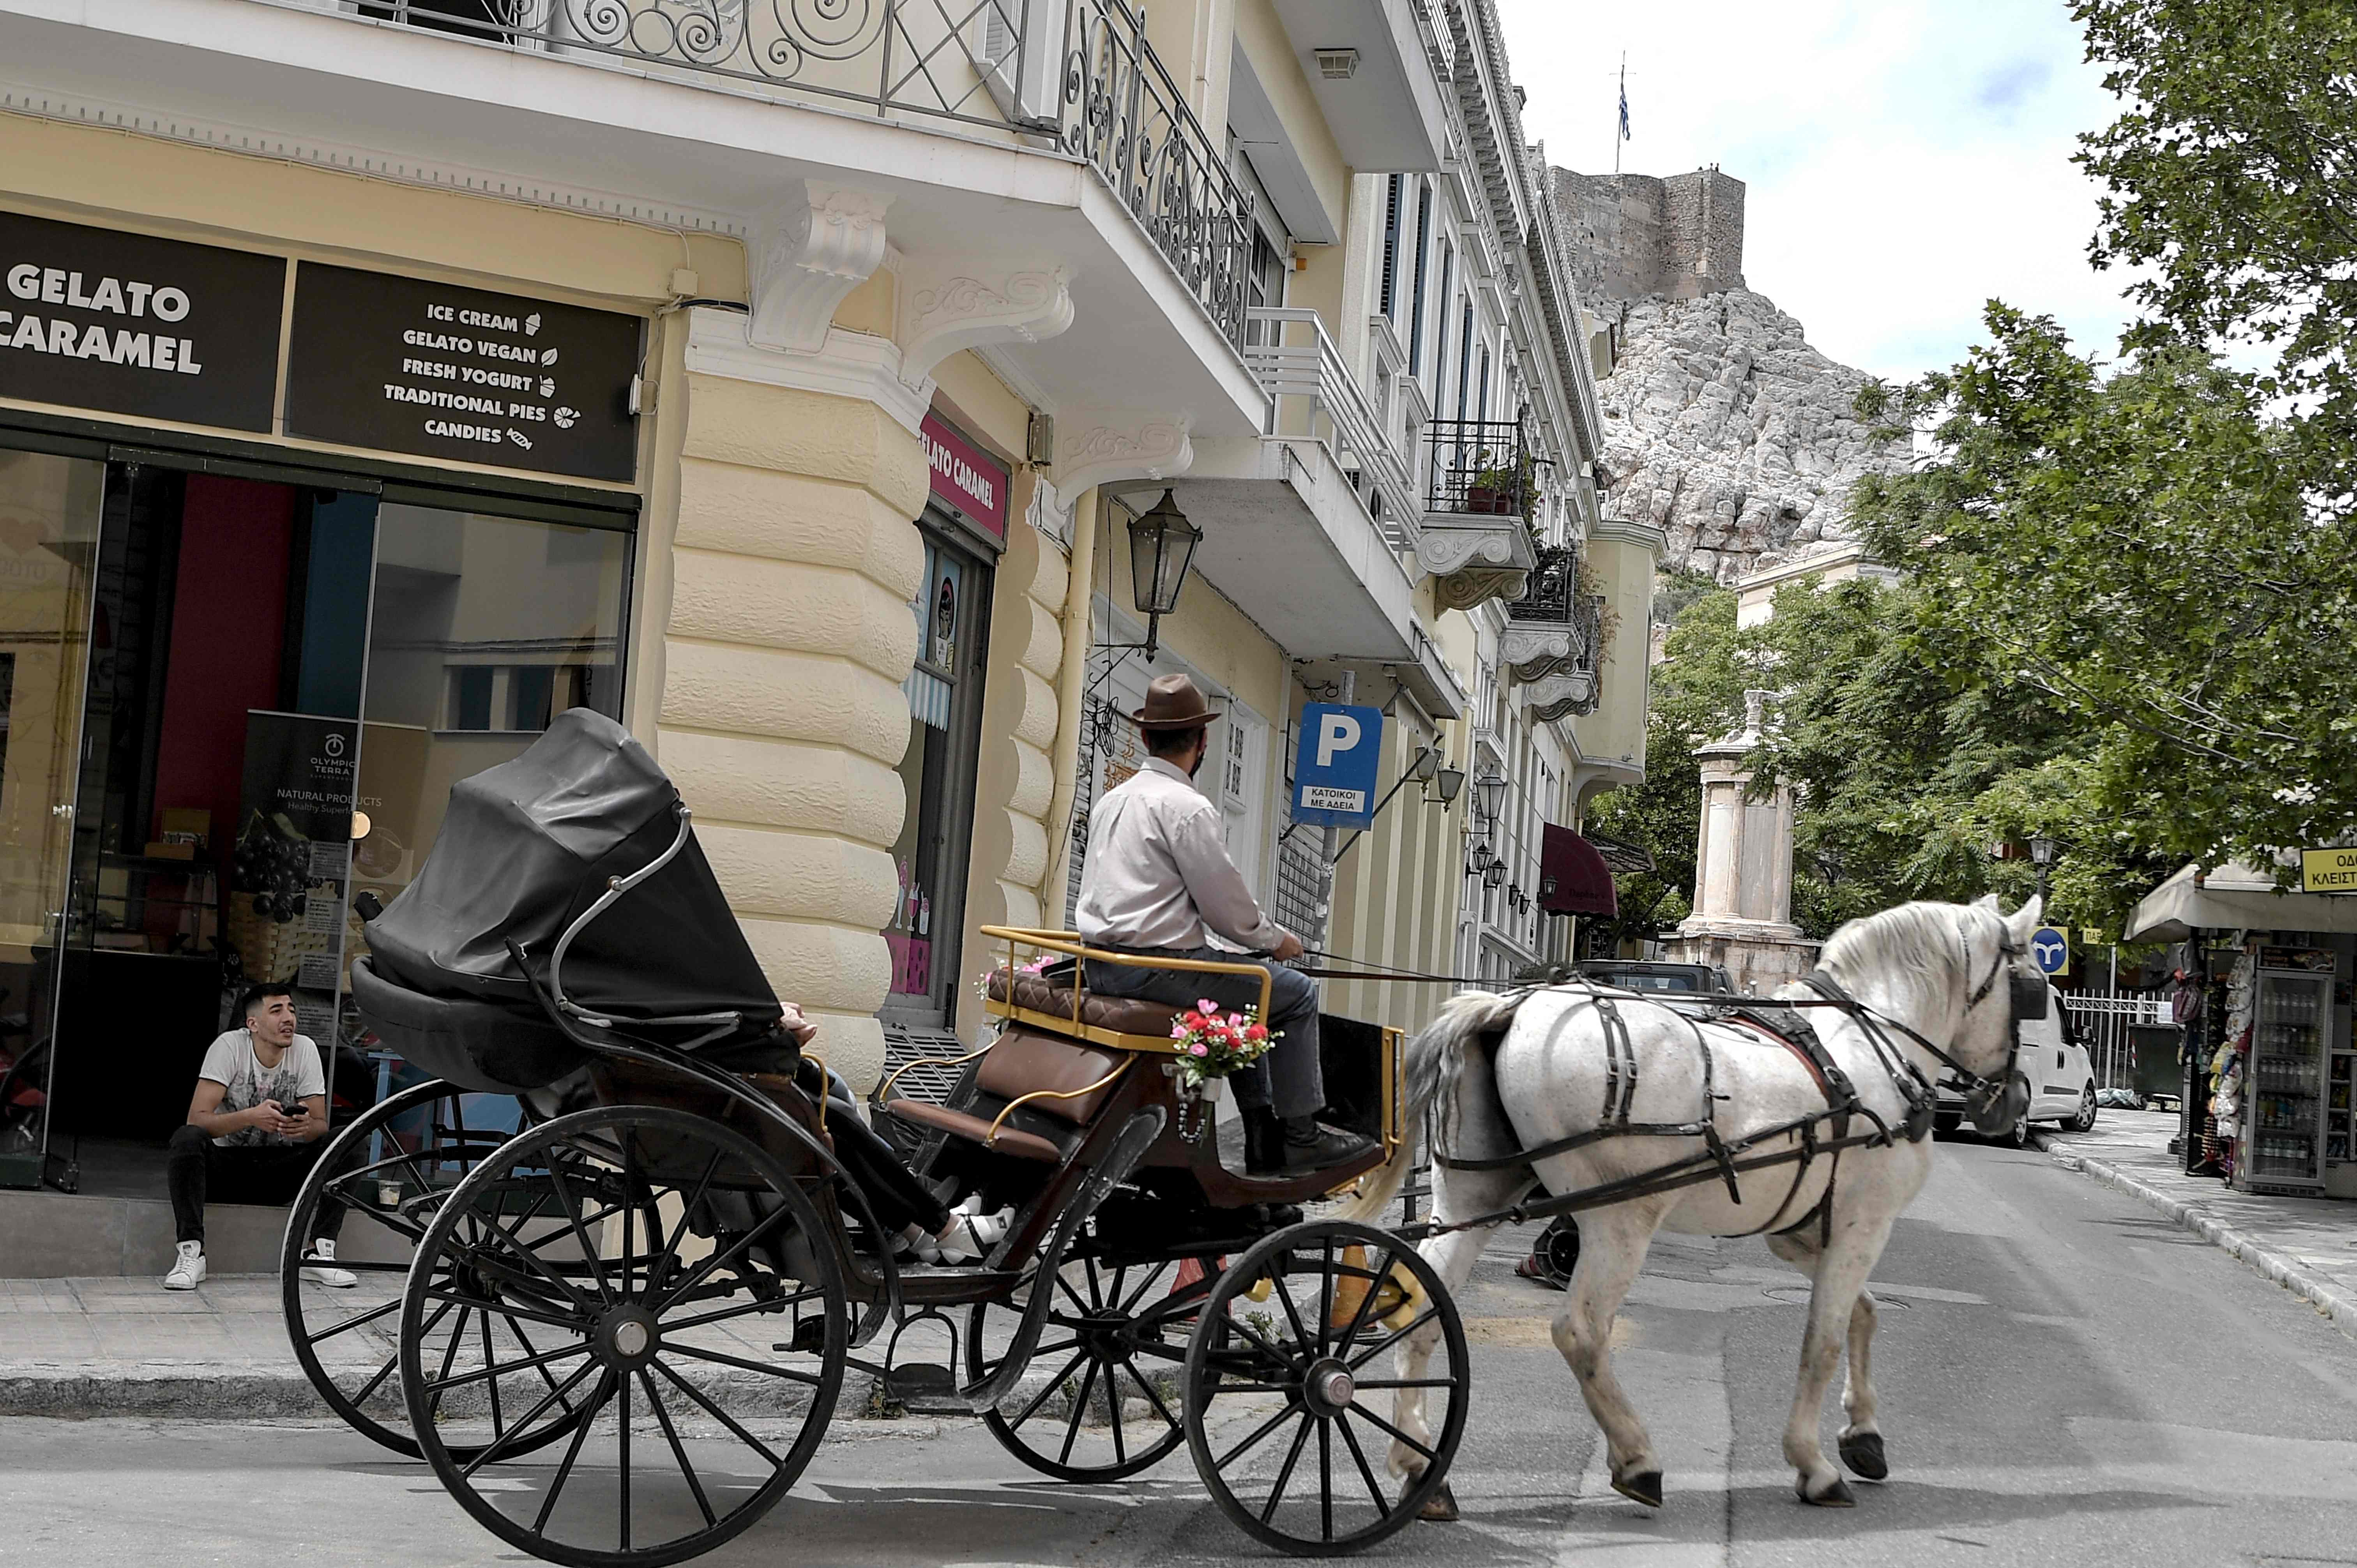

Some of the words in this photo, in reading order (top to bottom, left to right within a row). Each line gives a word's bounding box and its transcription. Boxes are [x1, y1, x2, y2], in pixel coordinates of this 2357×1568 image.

[7, 264, 190, 322] GELATO
[427, 304, 454, 321] ICE
[459, 310, 518, 332] CREAM
[0, 311, 202, 374] CARAMEL
[403, 330, 473, 353] GELATO
[477, 341, 536, 363] VEGAN
[403, 358, 456, 380] FRESH
[461, 367, 532, 391] YOGURT
[384, 384, 504, 415] TRADITIONAL
[509, 403, 546, 421] PIES
[425, 420, 501, 443] CANDIES
[918, 431, 952, 477] ELATO
[953, 457, 994, 510] CARAMEL
[1316, 713, 1360, 766] P
[311, 757, 355, 768] OLYMPIC
[315, 765, 350, 775] TERRA
[277, 789, 325, 802] NATURAL
[1311, 799, 1324, 807] ΜΕ
[1327, 800, 1354, 810] ΑΔΕΙΑ
[1312, 788, 1355, 800] ΚΑΤΟΙΚΟΙ
[288, 802, 319, 813] Healthy
[2337, 855, 2357, 867] ΟΔ
[2312, 872, 2357, 885] ΚΛΕΙΣΤ
